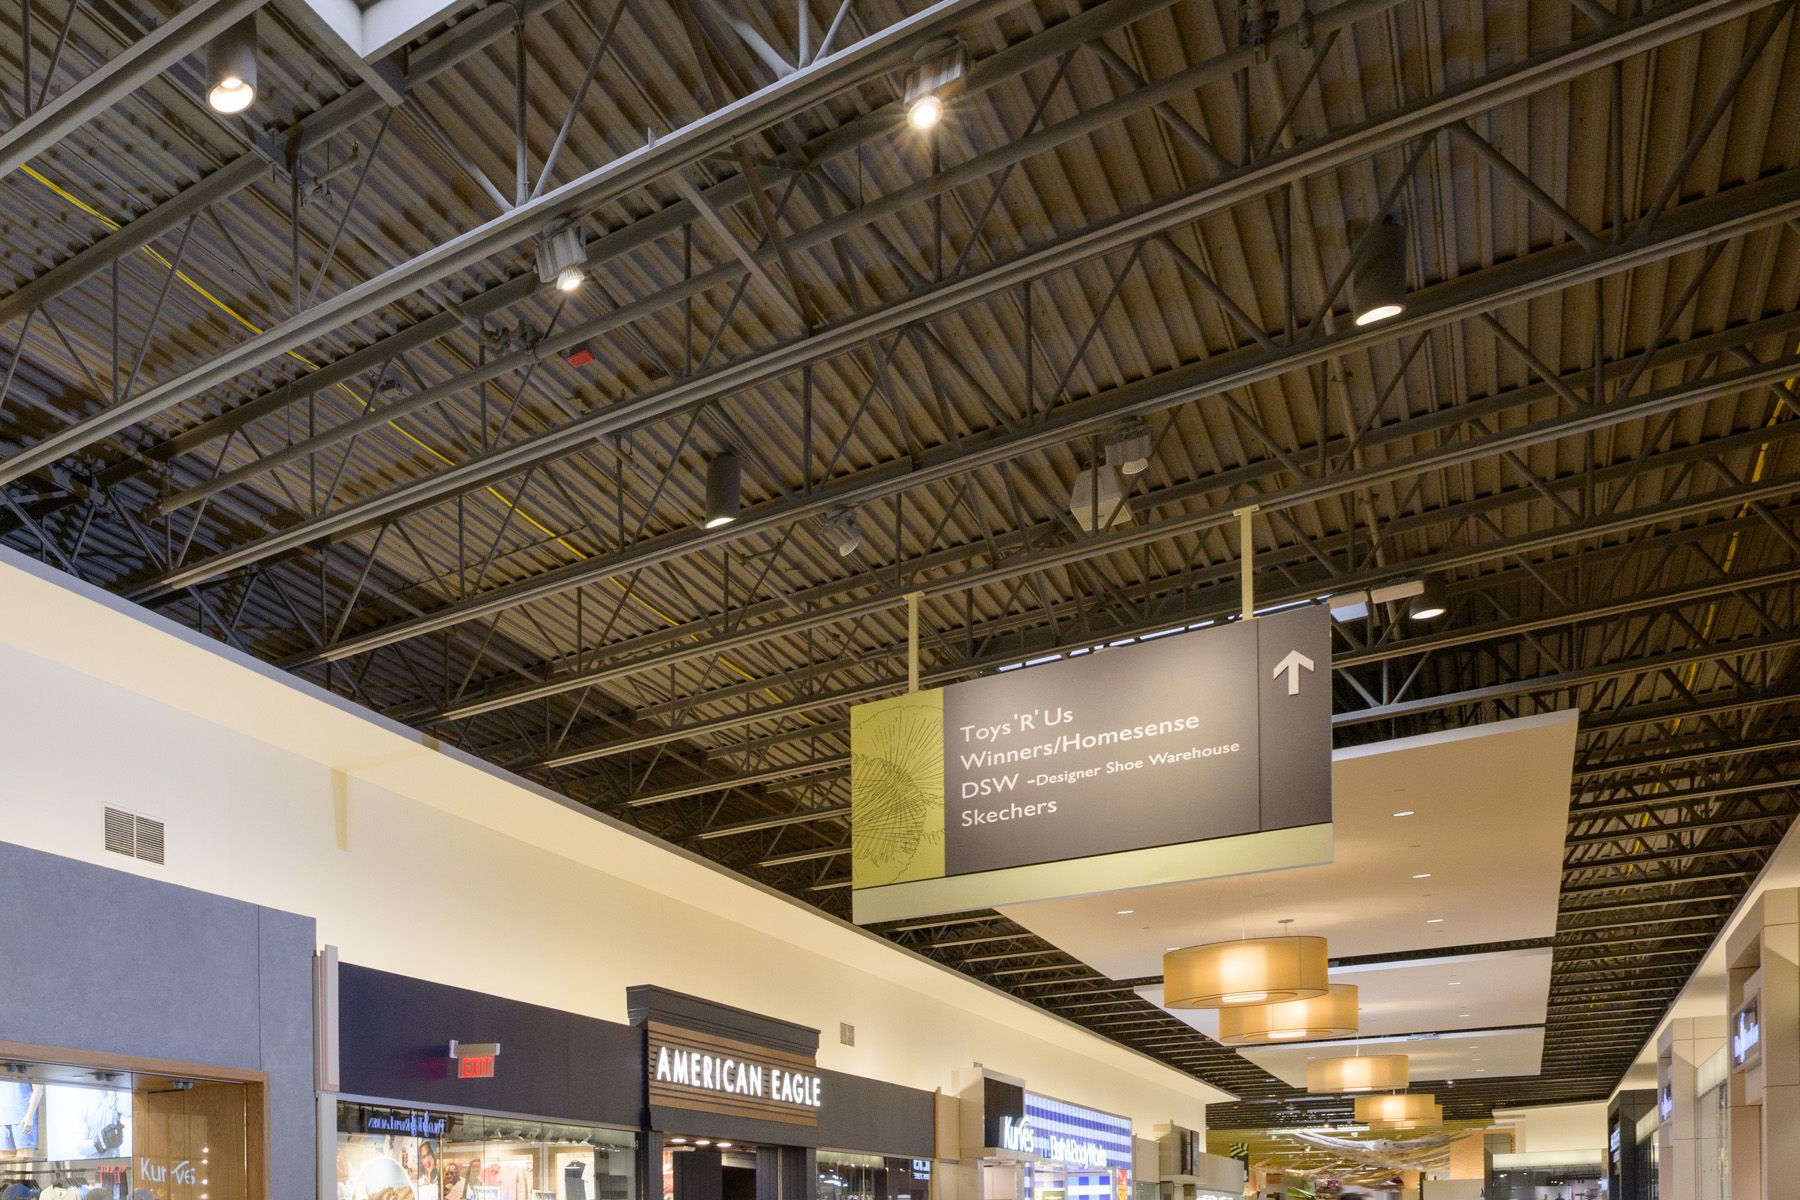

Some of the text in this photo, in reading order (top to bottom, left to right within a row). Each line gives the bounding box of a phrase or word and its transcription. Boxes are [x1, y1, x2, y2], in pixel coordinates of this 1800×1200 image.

[960, 725, 1012, 743] Toys
[1043, 707, 1074, 727] Us
[960, 715, 1200, 771] Winners/Homesense
[961, 773, 1020, 800] DSW
[1105, 758, 1144, 775] Shoe
[1148, 742, 1241, 767] Warehouse
[961, 800, 1058, 828] Skechers
[462, 1056, 490, 1078] EXIT
[656, 1046, 821, 1107] AMERICAN EAGLE
[1003, 1115, 1034, 1153] Kurves
